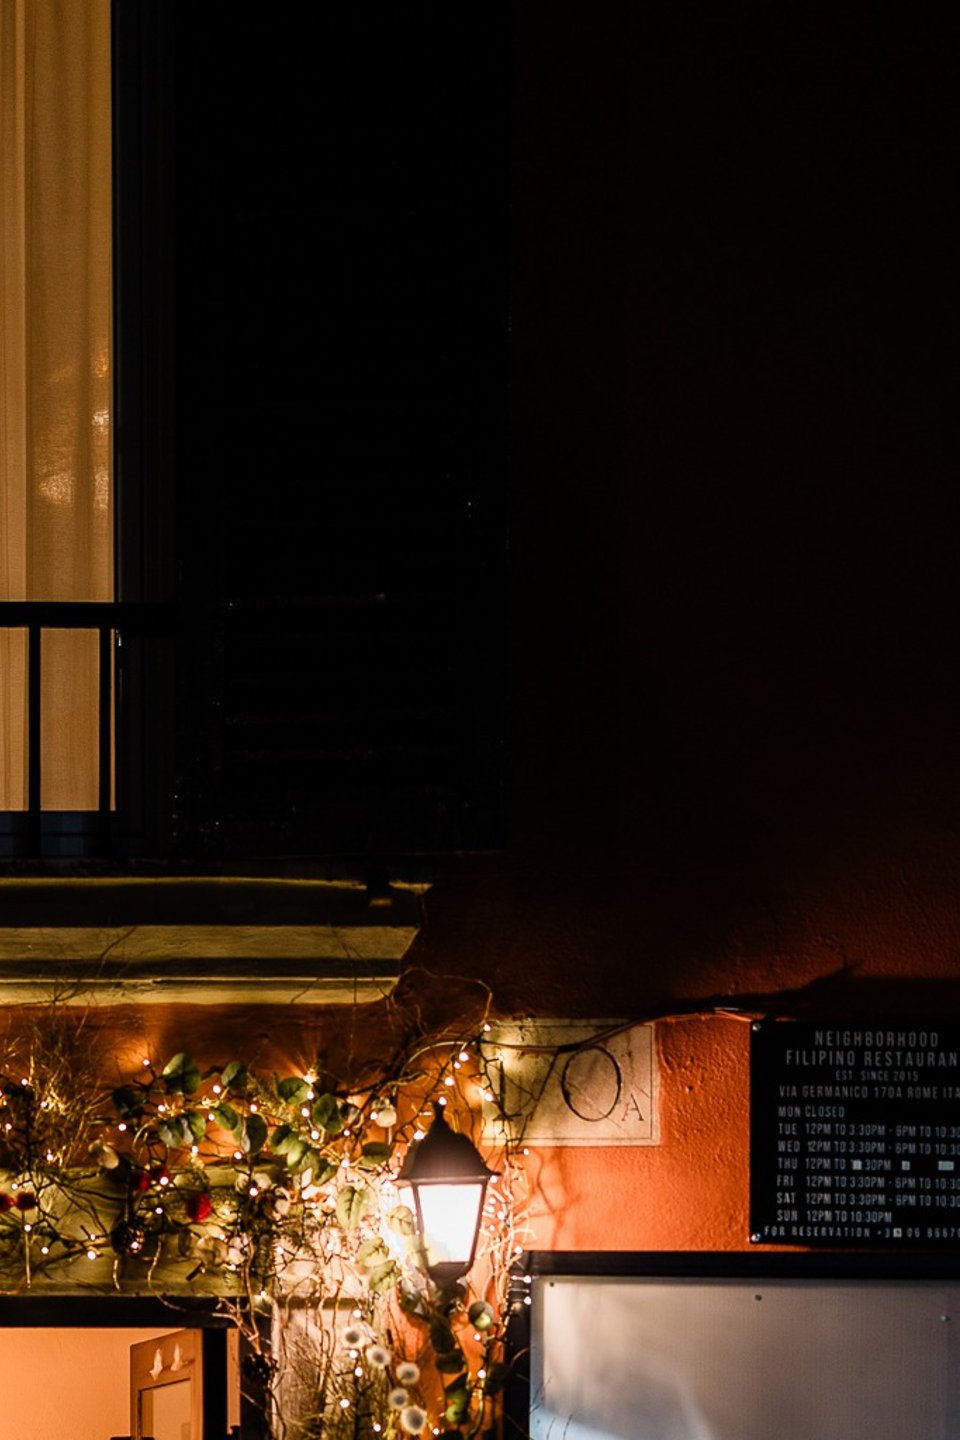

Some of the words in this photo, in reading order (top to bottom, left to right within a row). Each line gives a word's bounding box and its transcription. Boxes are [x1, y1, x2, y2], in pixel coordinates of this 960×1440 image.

[814, 1030, 939, 1048] NEIGHBORHOOD
[785, 1049, 856, 1067] FILIPINO
[860, 1070, 888, 1082] SINCE
[893, 1070, 919, 1082] 2015
[778, 1085, 798, 1098] VIA
[802, 1085, 868, 1099] GERMANICO
[874, 1086, 902, 1099] 170A
[907, 1086, 939, 1100] ROME
[777, 1105, 801, 1118] MON
[804, 1105, 846, 1118] CLOSED
[778, 1123, 798, 1135] TUE
[805, 1123, 832, 1135] 12PM
[834, 1123, 846, 1136] TO
[849, 1123, 886, 1137] 3:30PM
[919, 1125, 932, 1138] TO
[777, 1140, 801, 1153] WED
[807, 1140, 832, 1153] 12PM
[833, 1140, 846, 1153] TO
[848, 1141, 885, 1154] 3:30PM
[919, 1142, 932, 1155] TO
[777, 1158, 798, 1170] THU
[804, 1158, 831, 1170] 12PM
[833, 1158, 846, 1171] TO
[776, 1175, 794, 1187] FRI
[806, 1175, 832, 1187] 12PM
[834, 1176, 847, 1188] TO
[849, 1175, 885, 1189] 3:30PM
[919, 1177, 932, 1190] TO
[776, 1191, 796, 1204] SAT
[805, 1192, 831, 1205] 12PM
[834, 1193, 847, 1205] TO
[849, 1193, 886, 1206] 3:30PM
[919, 1194, 932, 1207] TO
[776, 1209, 798, 1222] SUN
[806, 1210, 832, 1222] 12PM
[835, 1210, 847, 1223] TO
[849, 1210, 892, 1224] 10:30PM
[763, 1225, 785, 1237] FOR
[791, 1225, 870, 1238] RESERVATION
